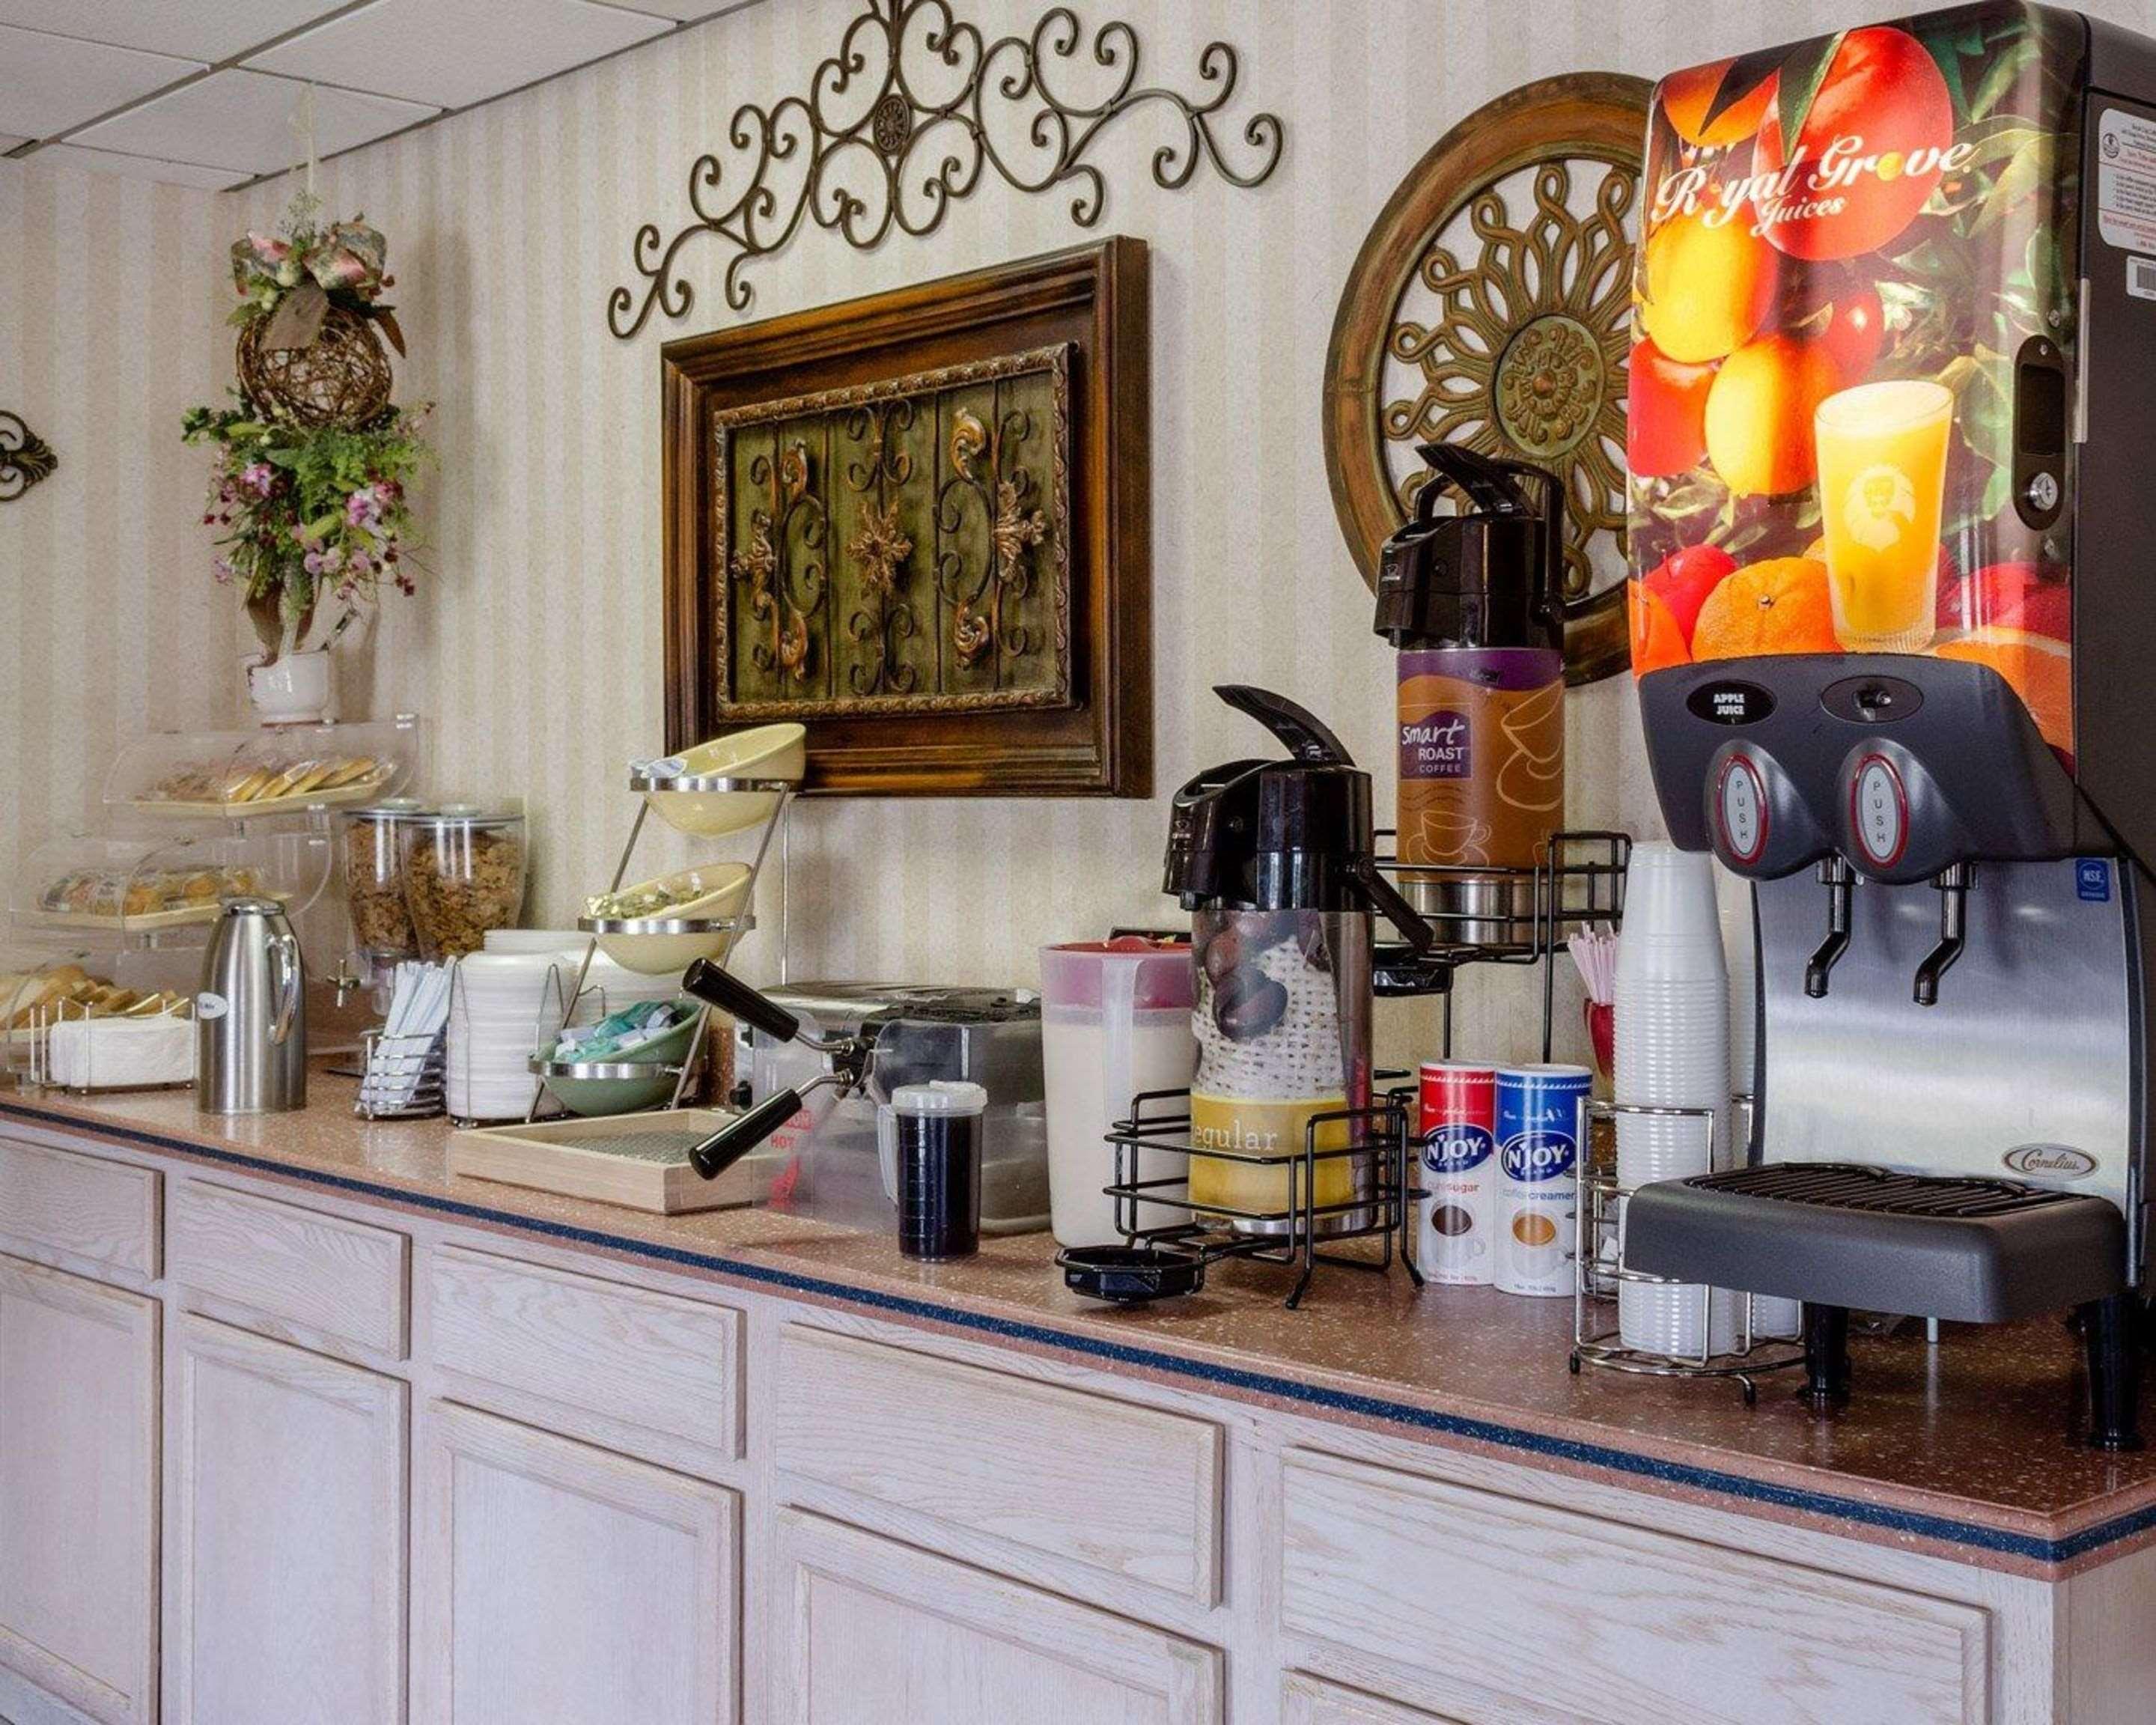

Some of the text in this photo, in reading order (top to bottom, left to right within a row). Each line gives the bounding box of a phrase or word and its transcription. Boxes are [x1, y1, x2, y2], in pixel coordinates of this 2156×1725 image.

[1808, 134, 1974, 191] Grove
[1750, 195, 1845, 237] Juices
[1713, 693, 1745, 704] APPLE
[1716, 705, 1745, 715] JUICE
[1401, 718, 1466, 746] smart
[1418, 746, 1465, 761] ROAST
[1419, 764, 1461, 773] COFFEE
[1735, 779, 1749, 839] PUSH
[1872, 780, 1886, 842] PUSH
[1192, 1119, 1278, 1151] egular
[1446, 1183, 1480, 1193] sugar
[1528, 1192, 1575, 1201] creamer
